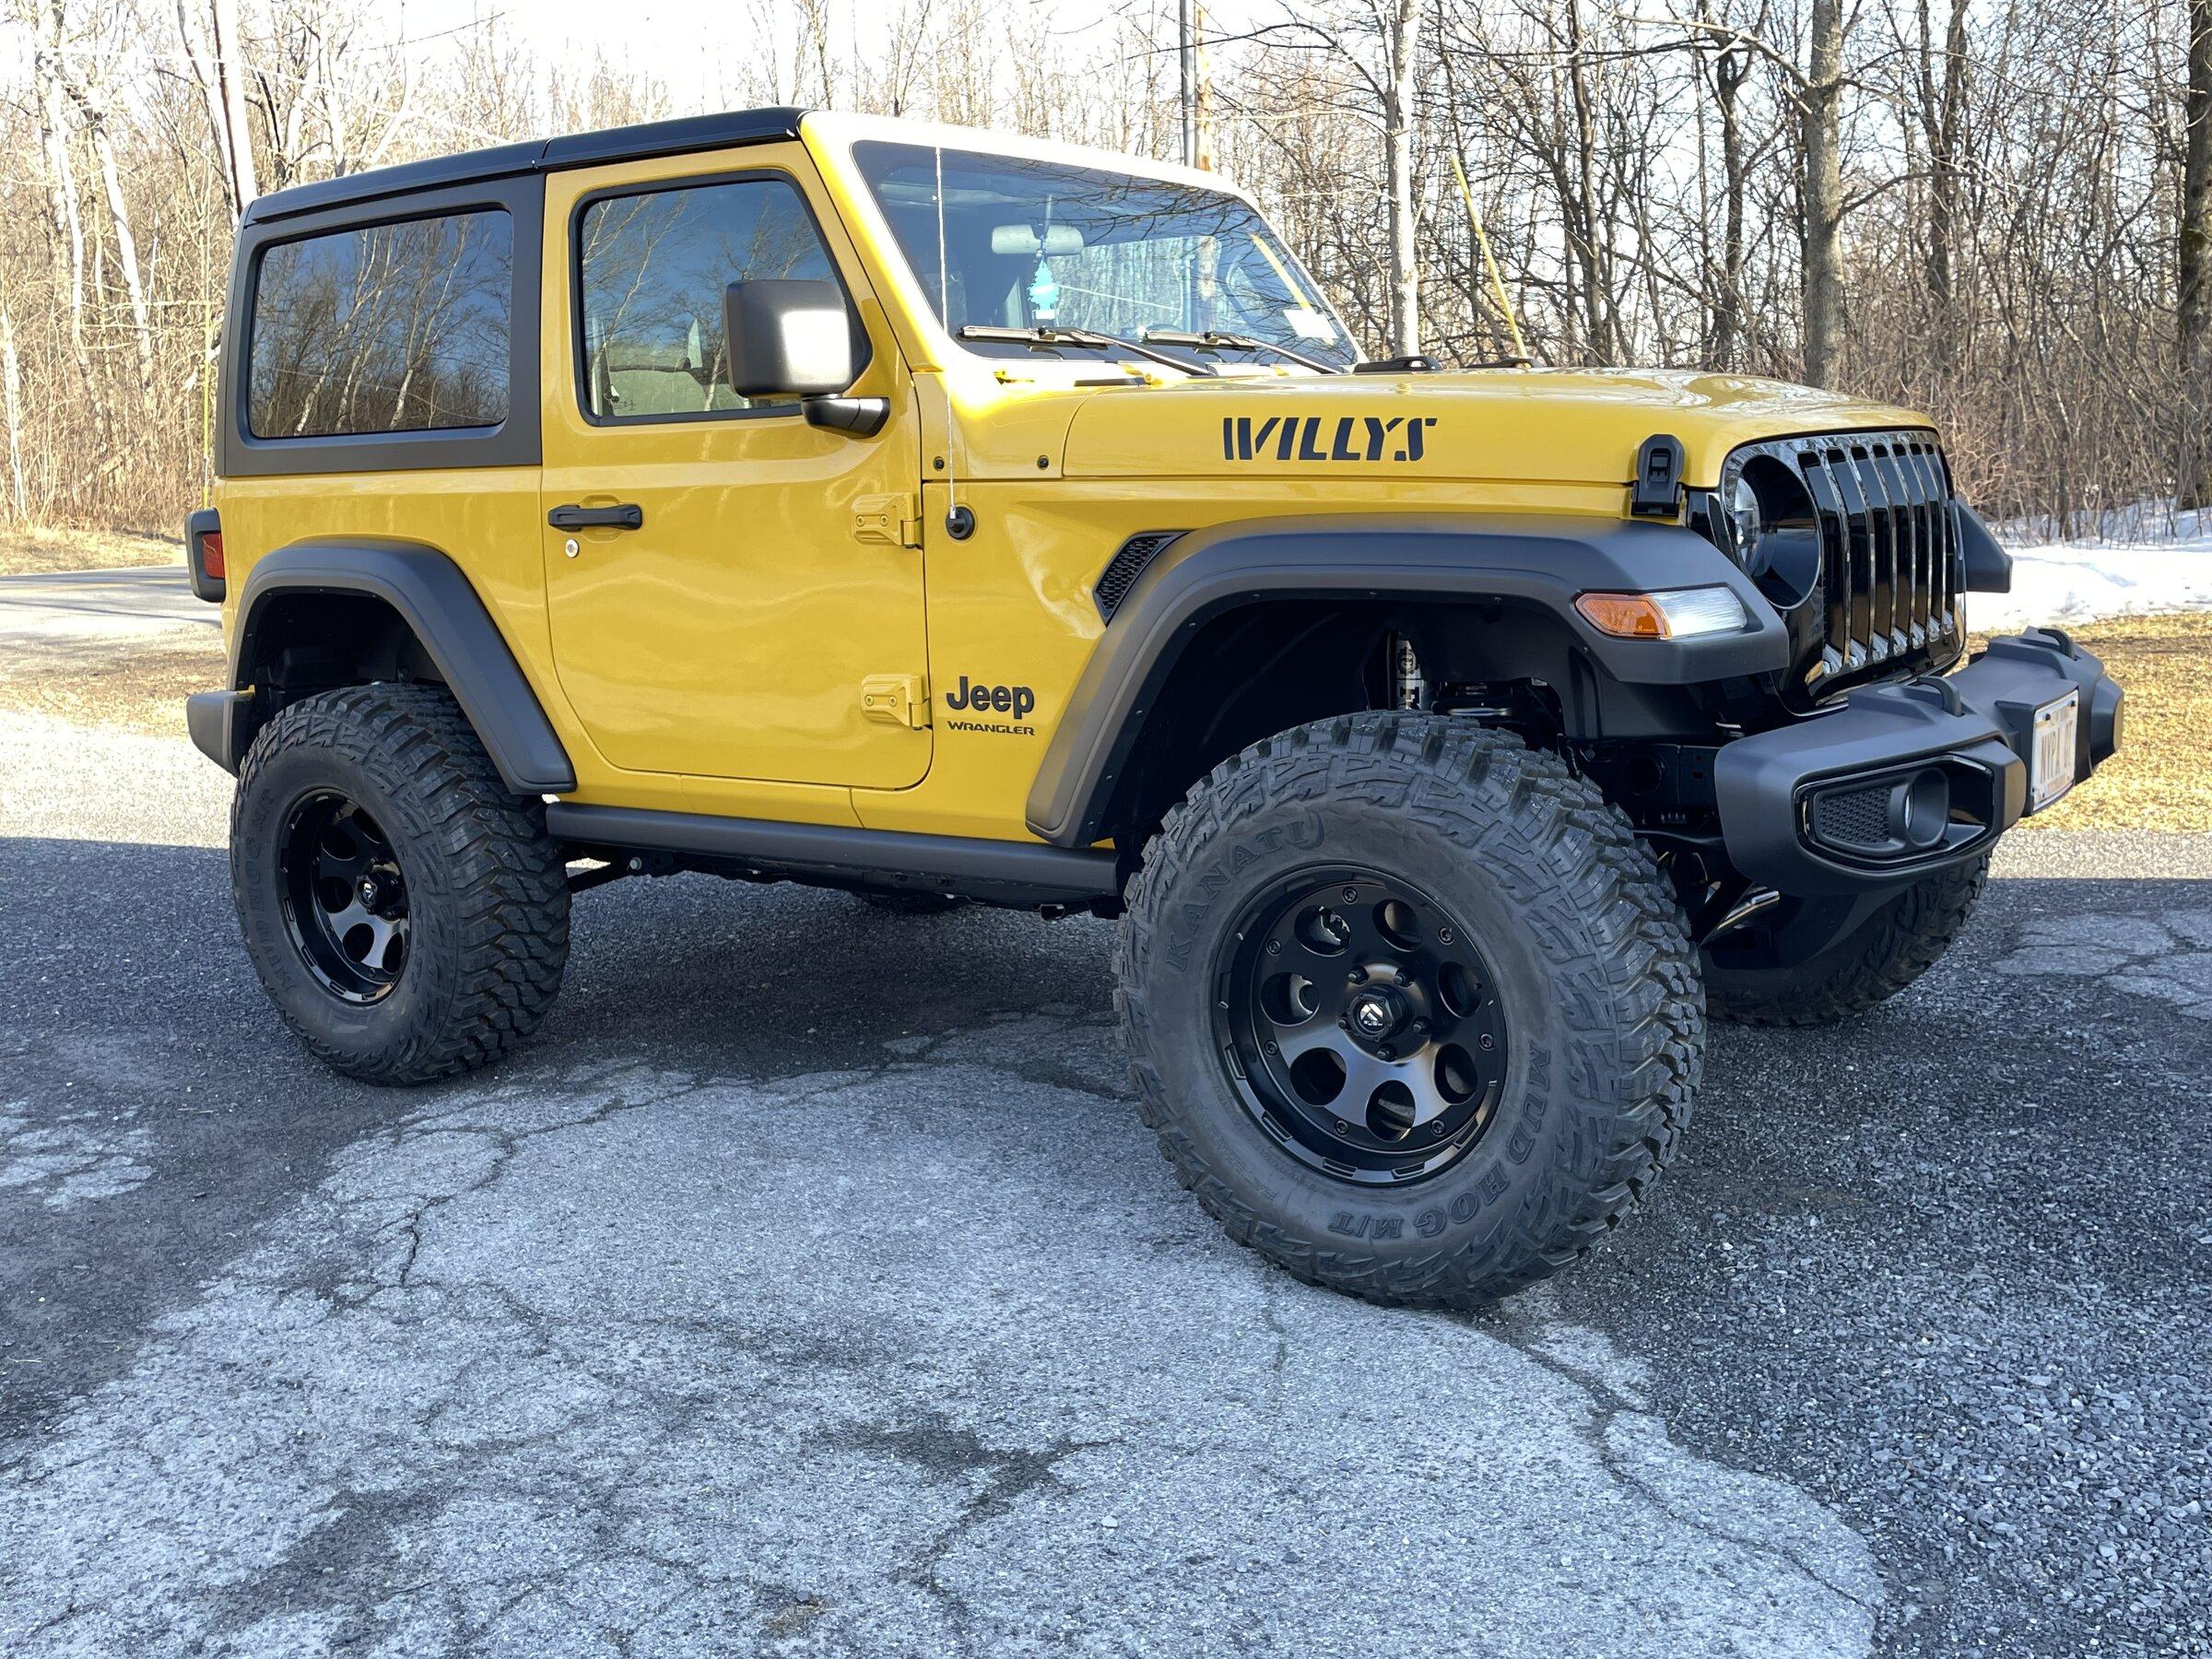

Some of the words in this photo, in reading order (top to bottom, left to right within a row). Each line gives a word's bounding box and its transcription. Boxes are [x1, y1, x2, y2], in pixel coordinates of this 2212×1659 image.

[1223, 417, 1438, 461] WILLYS
[947, 676, 1034, 720] Jeep
[947, 721, 1035, 735] WRANGLER
[1507, 1039, 1550, 1165] MUD
[1415, 1160, 1510, 1238] HOG
[1327, 1212, 1404, 1239] M/T
